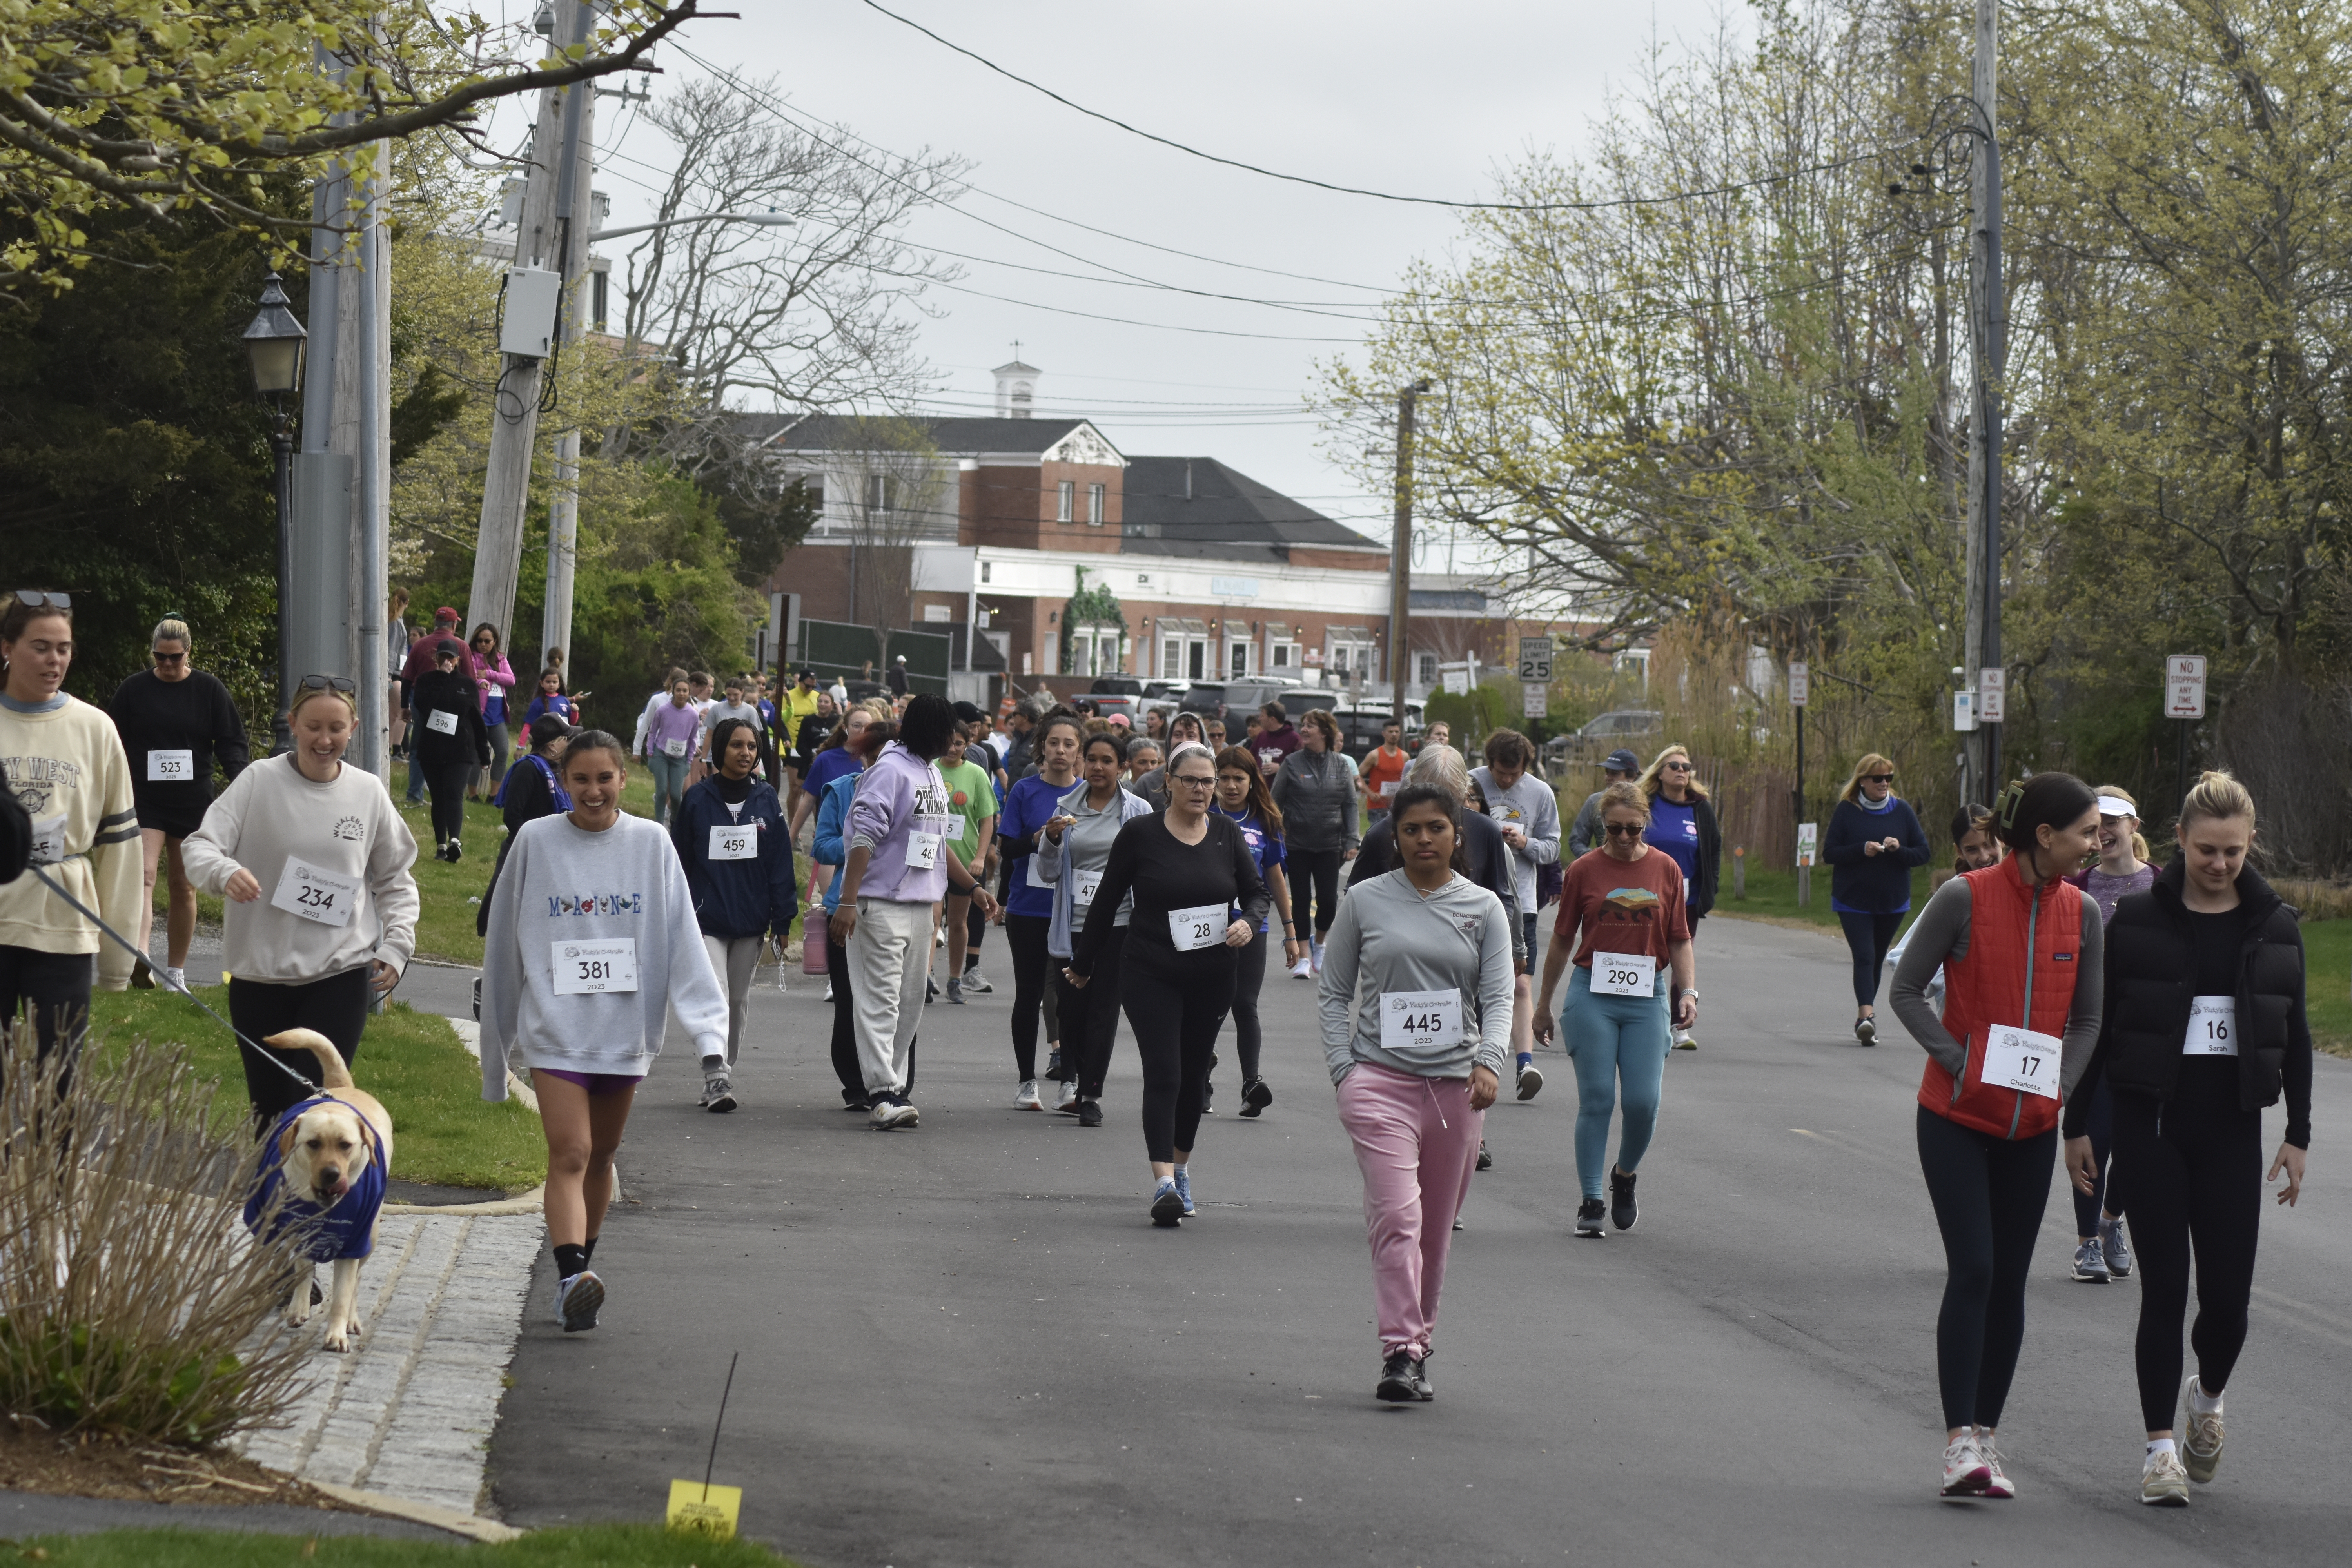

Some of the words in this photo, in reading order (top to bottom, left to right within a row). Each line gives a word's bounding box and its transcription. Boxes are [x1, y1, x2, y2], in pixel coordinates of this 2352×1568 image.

[1523, 662, 1548, 677] 25
[2180, 662, 2193, 673] NO
[2171, 675, 2201, 684] STOPPING
[436, 719, 448, 728] 596
[0, 757, 21, 779] EY
[27, 757, 80, 788] WEST
[161, 762, 181, 773] 523
[914, 785, 933, 814] 2nd
[926, 799, 944, 813] WIND
[334, 816, 364, 842] WHALEBONE
[723, 839, 745, 851] 459
[921, 847, 935, 860] 463
[296, 885, 335, 910] 234
[1082, 885, 1096, 897] 47
[549, 893, 640, 916] MAINE
[302, 909, 320, 918] 2023
[1193, 923, 1210, 938] 28
[579, 961, 610, 980] 381
[1607, 970, 1638, 985] 290
[1403, 1013, 1442, 1033] 445
[2207, 1020, 2228, 1040] 16
[2022, 1040, 2040, 1051] Katy's
[2022, 1055, 2041, 1076] 17
[2010, 1079, 2041, 1091] Charlotte
